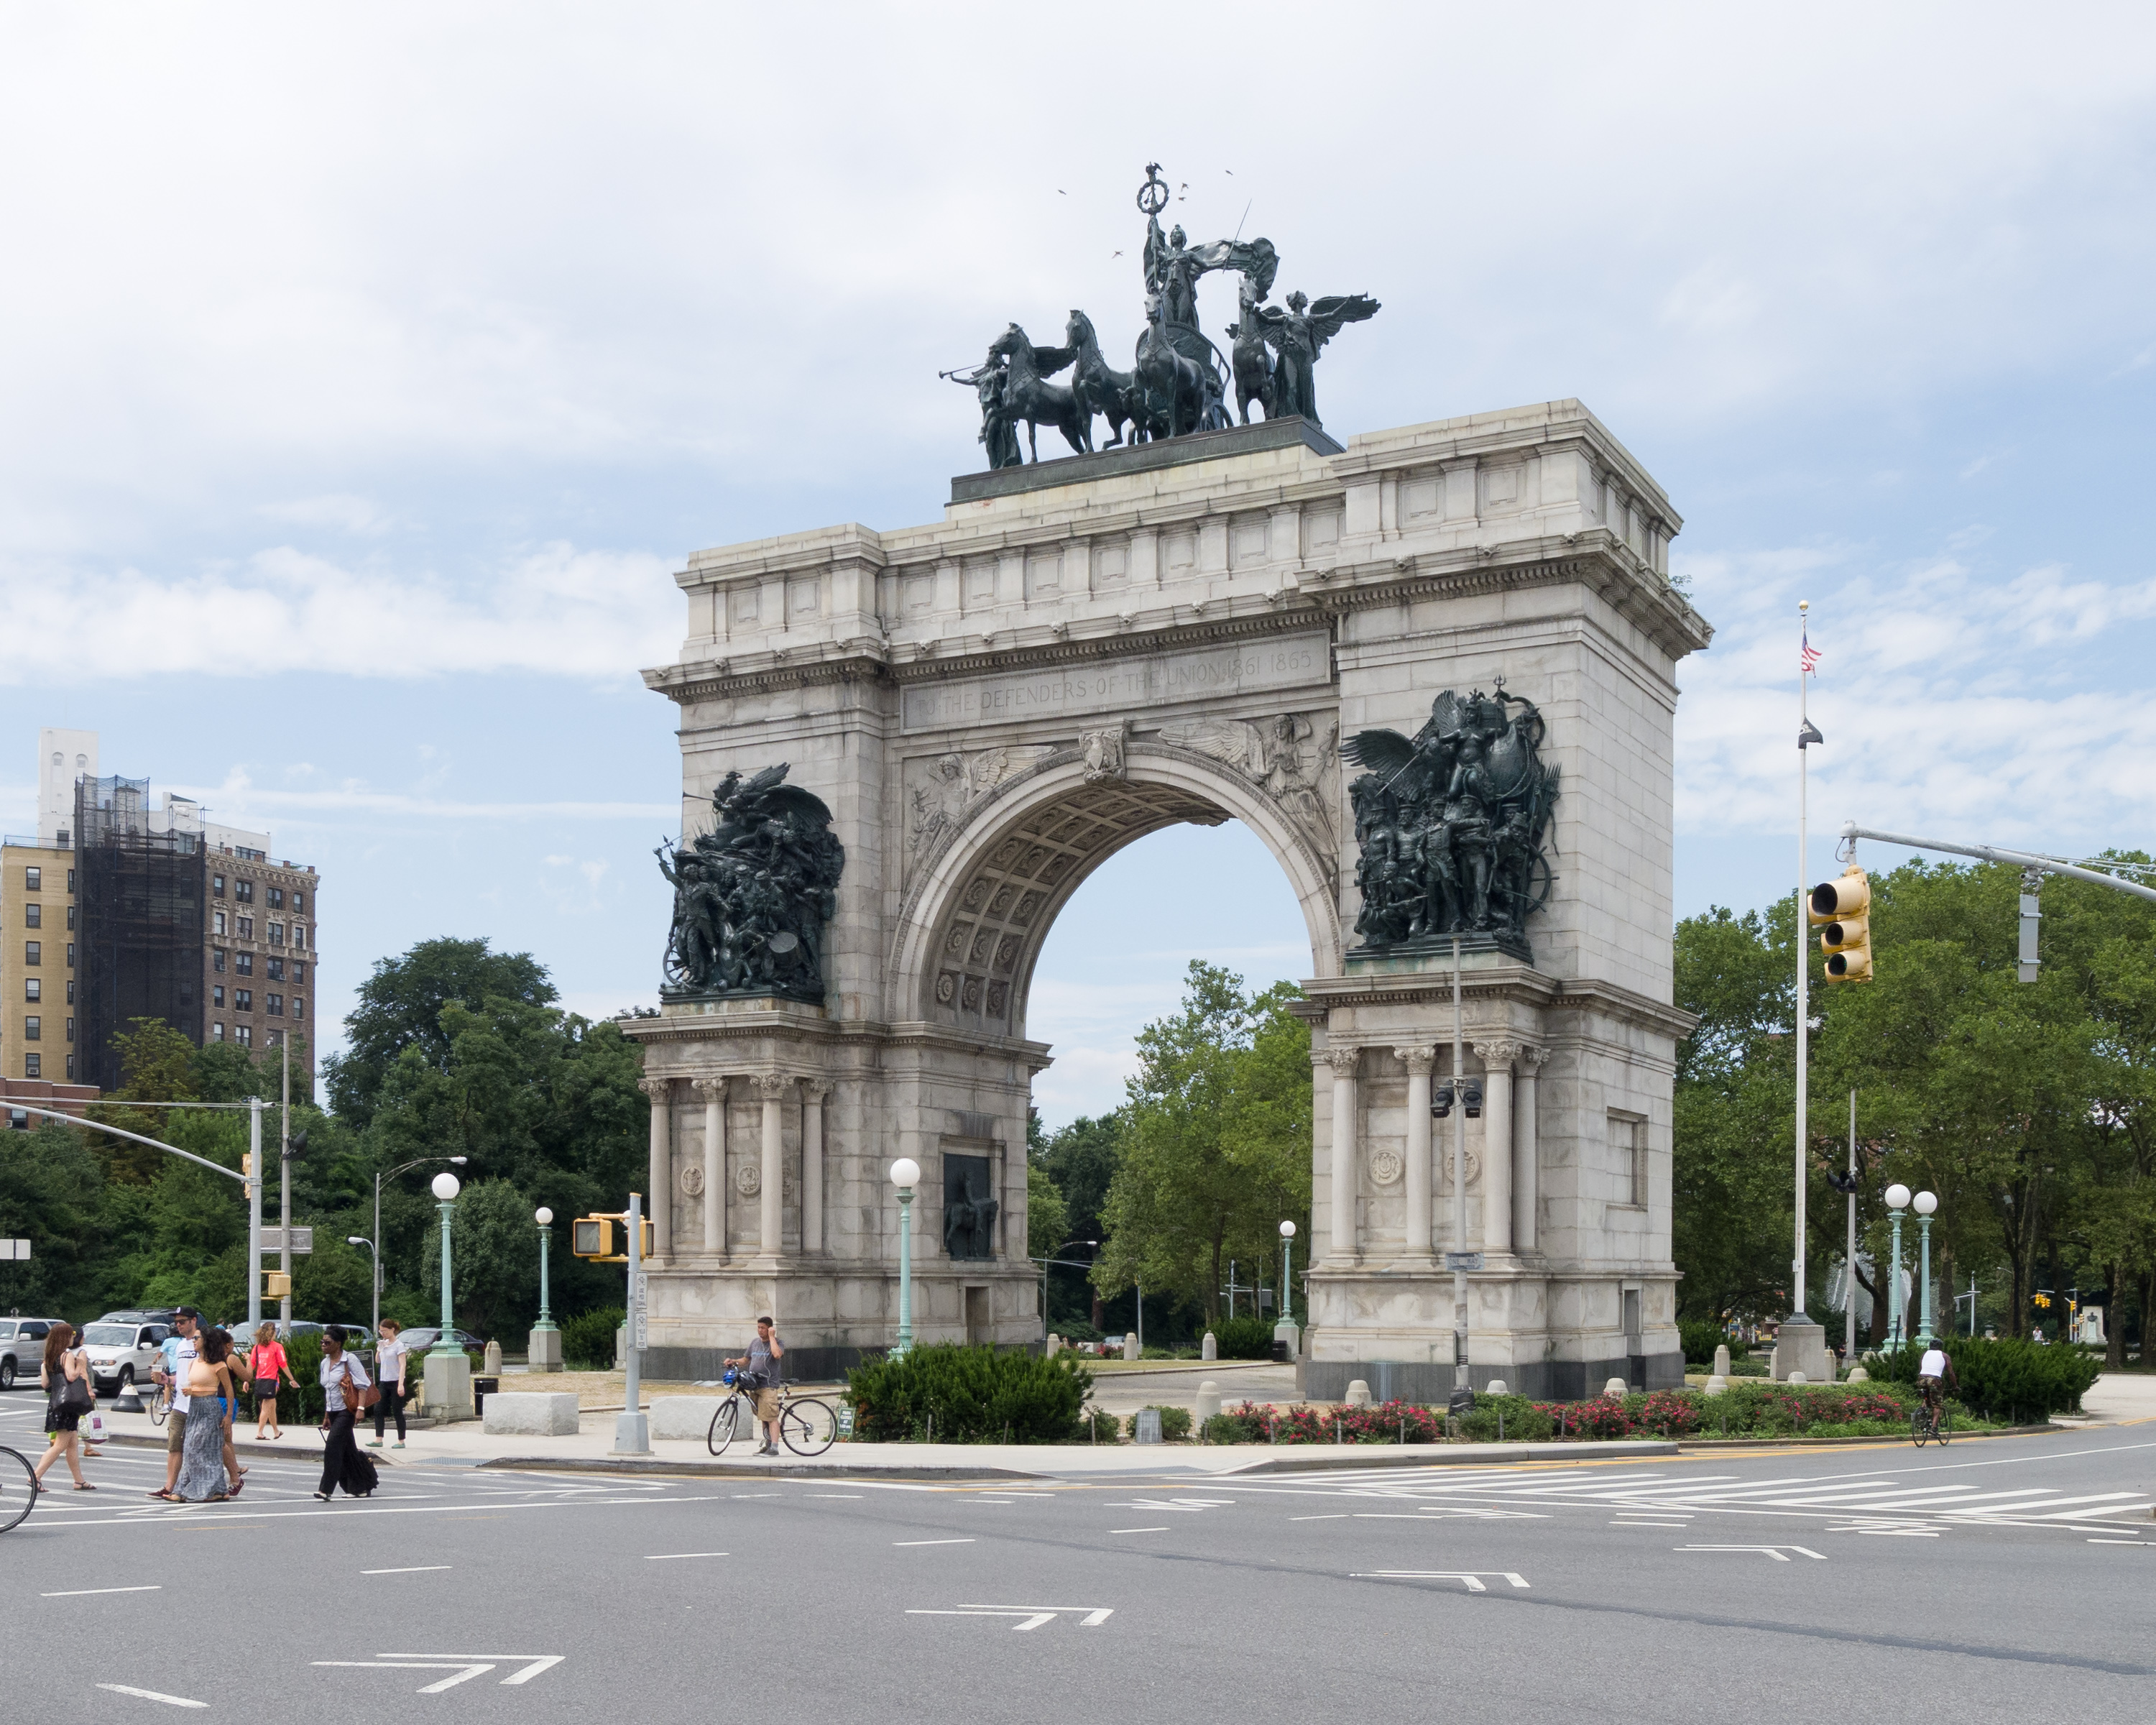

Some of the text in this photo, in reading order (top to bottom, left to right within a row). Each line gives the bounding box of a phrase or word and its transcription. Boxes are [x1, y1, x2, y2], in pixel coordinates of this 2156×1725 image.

[916, 650, 1311, 715] TO THE DEFENDERS OF THE UNION 1861 1865
